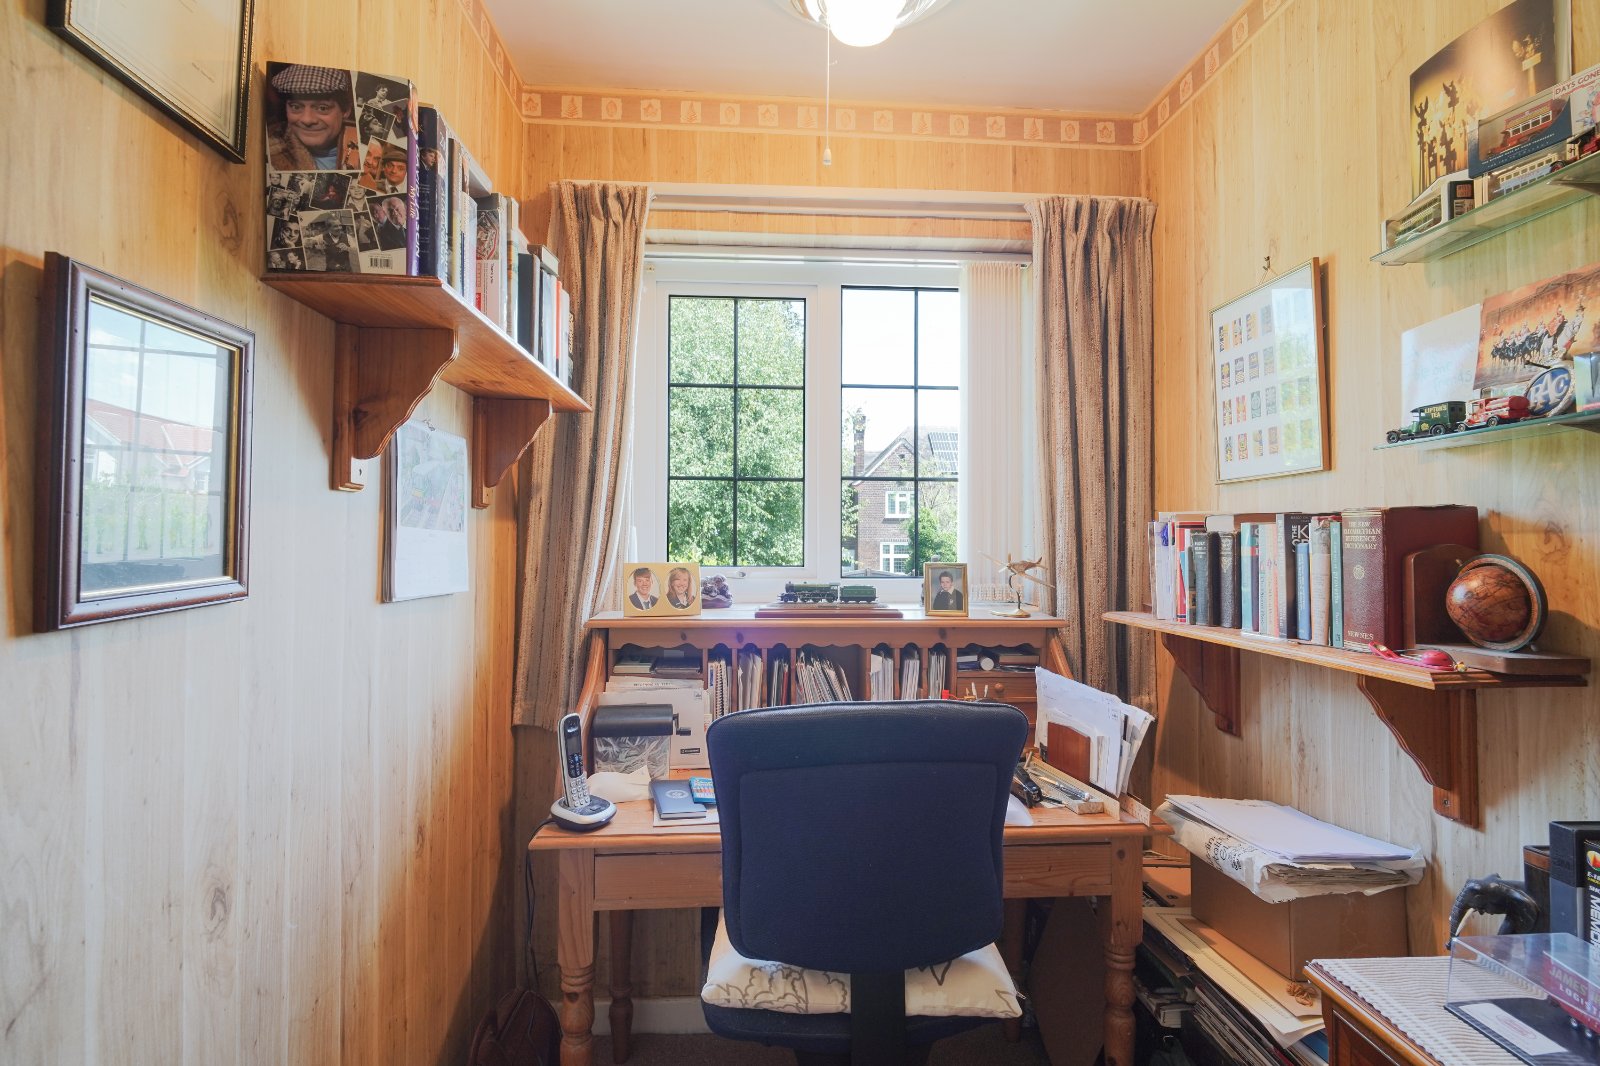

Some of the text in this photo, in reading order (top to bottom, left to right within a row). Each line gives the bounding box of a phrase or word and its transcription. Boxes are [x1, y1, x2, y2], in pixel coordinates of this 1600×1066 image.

[1555, 82, 1576, 95] DAYS
[1577, 69, 1600, 85] GONE
[409, 185, 416, 199] My
[1529, 373, 1569, 408] RAC
[1430, 412, 1441, 420] TEA
[1344, 542, 1377, 550] DICTIONARY
[1347, 630, 1374, 641] NEWNES
[1549, 965, 1587, 996] JAMES
